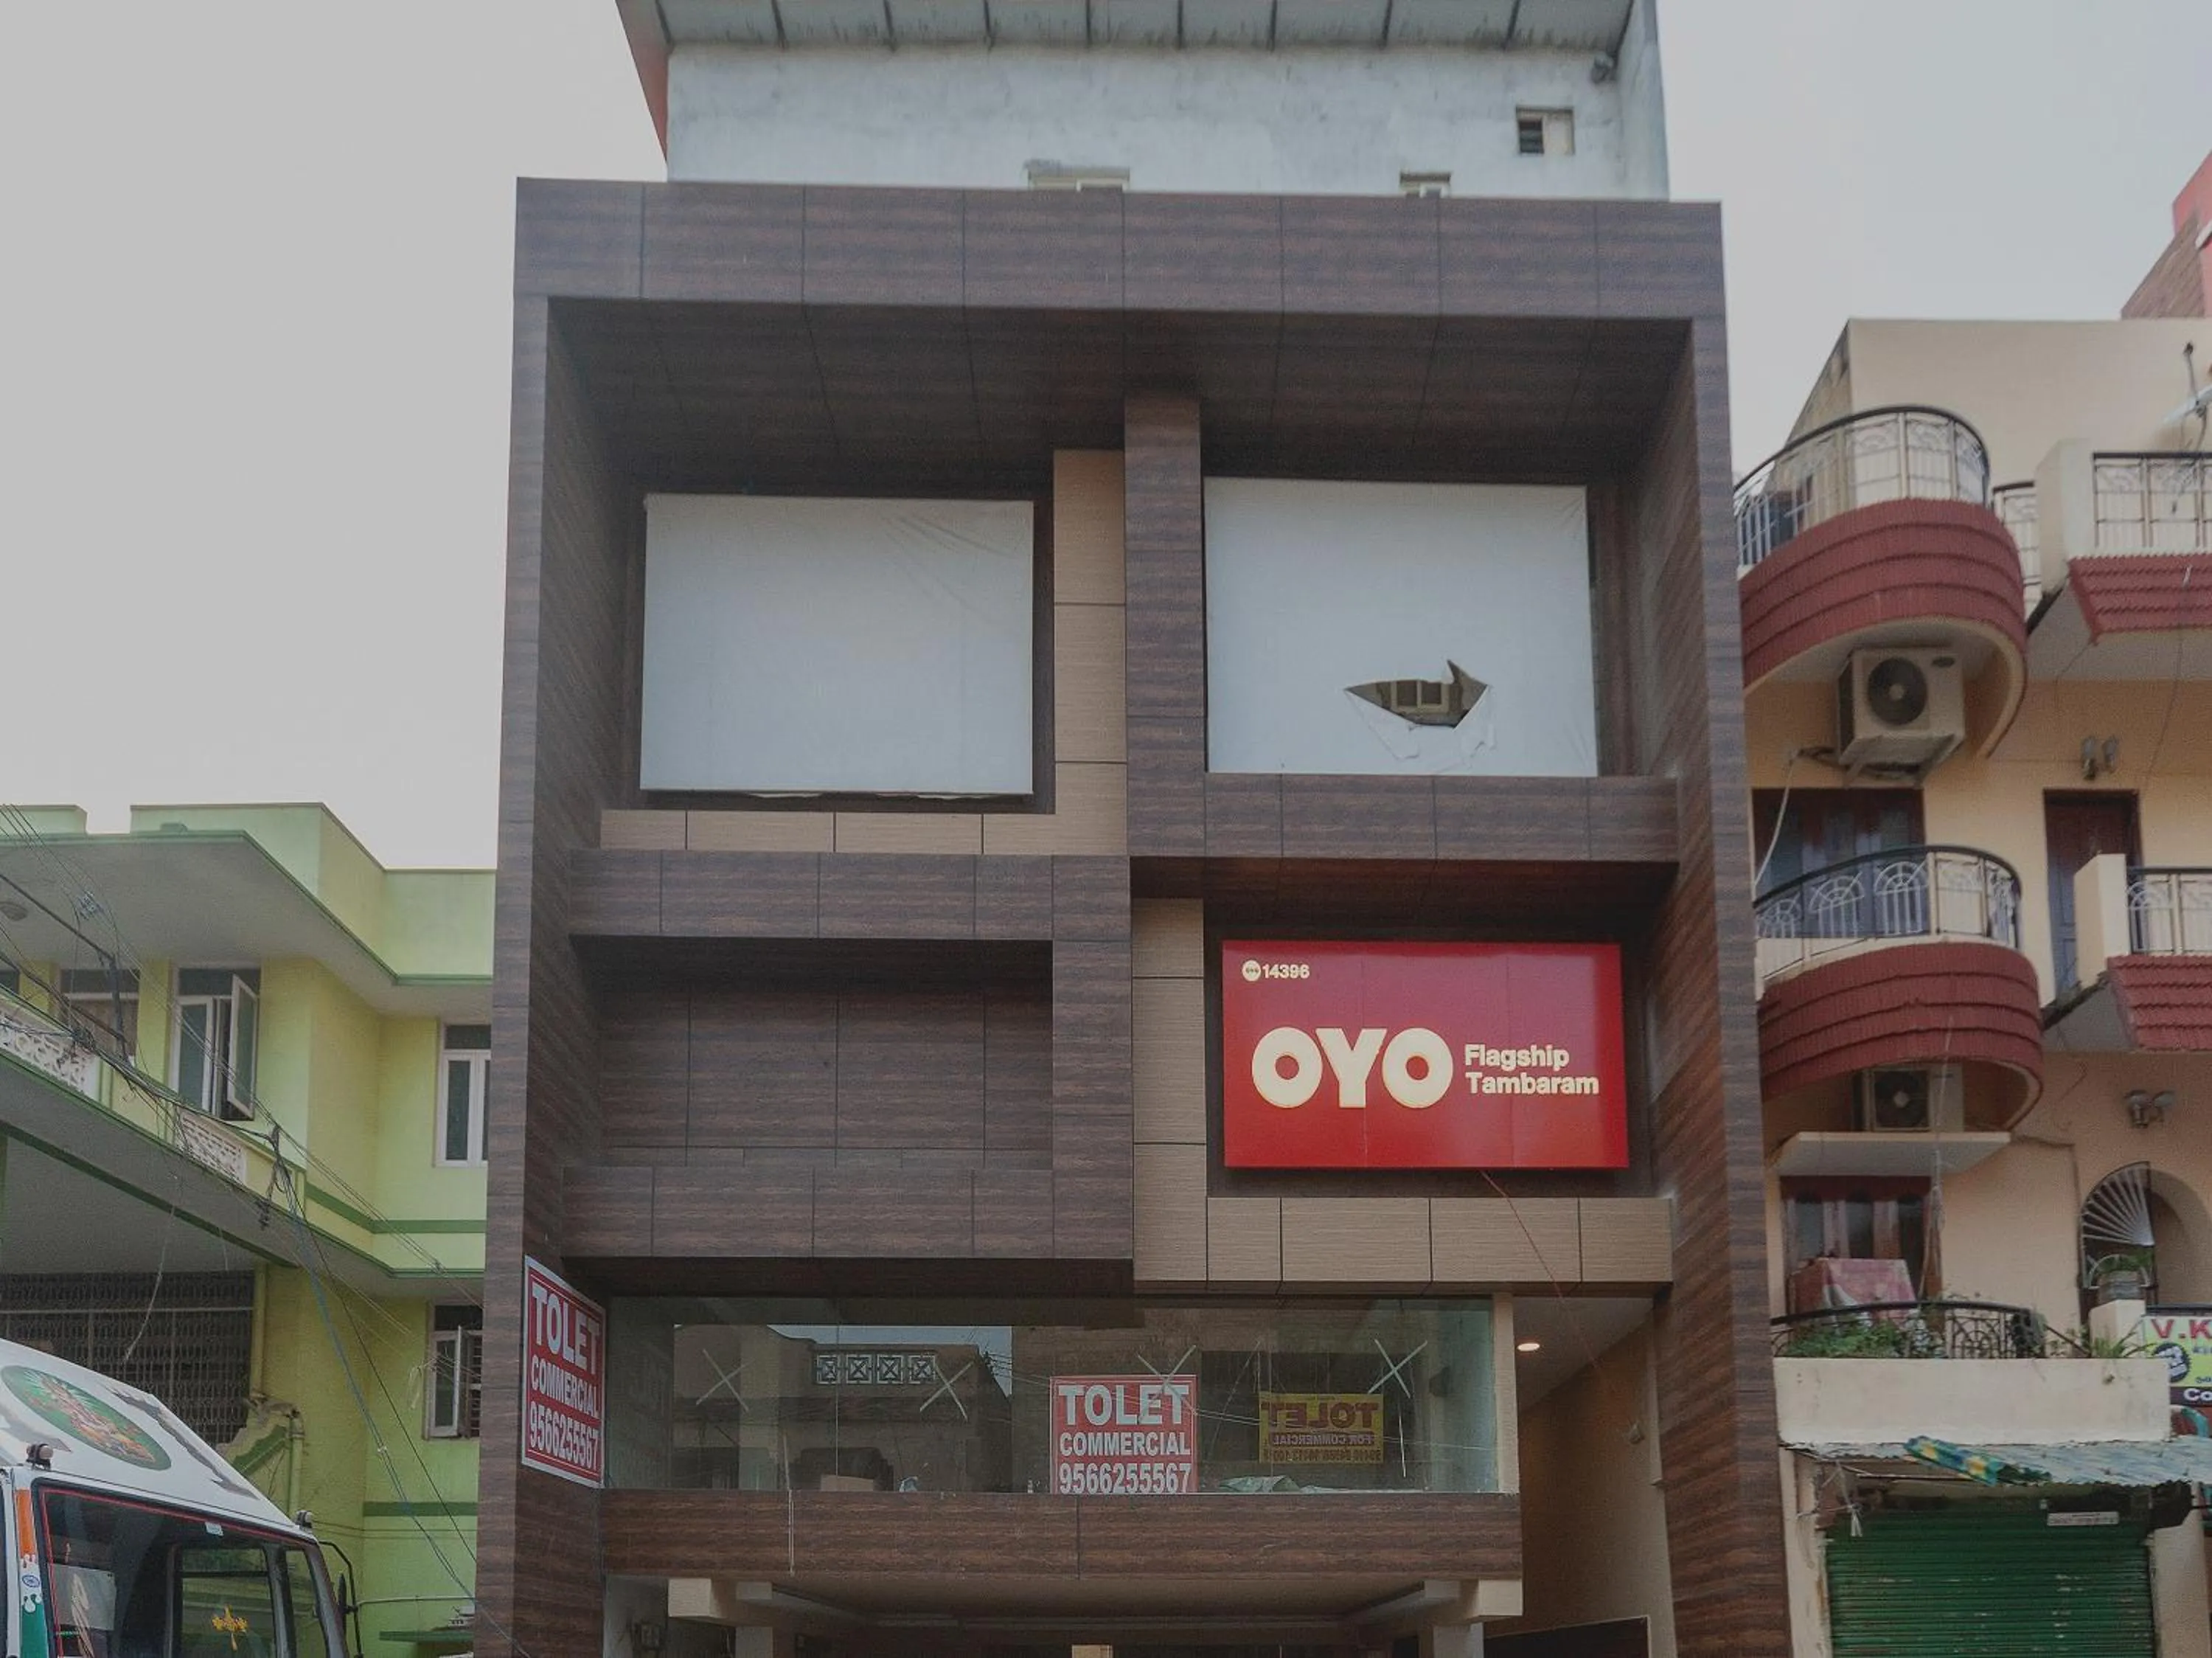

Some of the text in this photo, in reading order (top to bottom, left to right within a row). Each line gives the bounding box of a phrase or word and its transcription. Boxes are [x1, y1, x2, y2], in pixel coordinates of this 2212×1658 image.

[1251, 1027, 1454, 1109] OYO
[1464, 1044, 1571, 1072] Flagship
[1465, 1072, 1599, 1096] Tambaram
[532, 1282, 599, 1376] TOLET
[531, 1354, 599, 1418] COMMERCIAL
[1058, 1384, 1189, 1426] TOLET
[529, 1400, 599, 1471] 9566255567
[1060, 1431, 1191, 1457] COMMERCIAL
[1060, 1463, 1192, 1495] 9566255567
